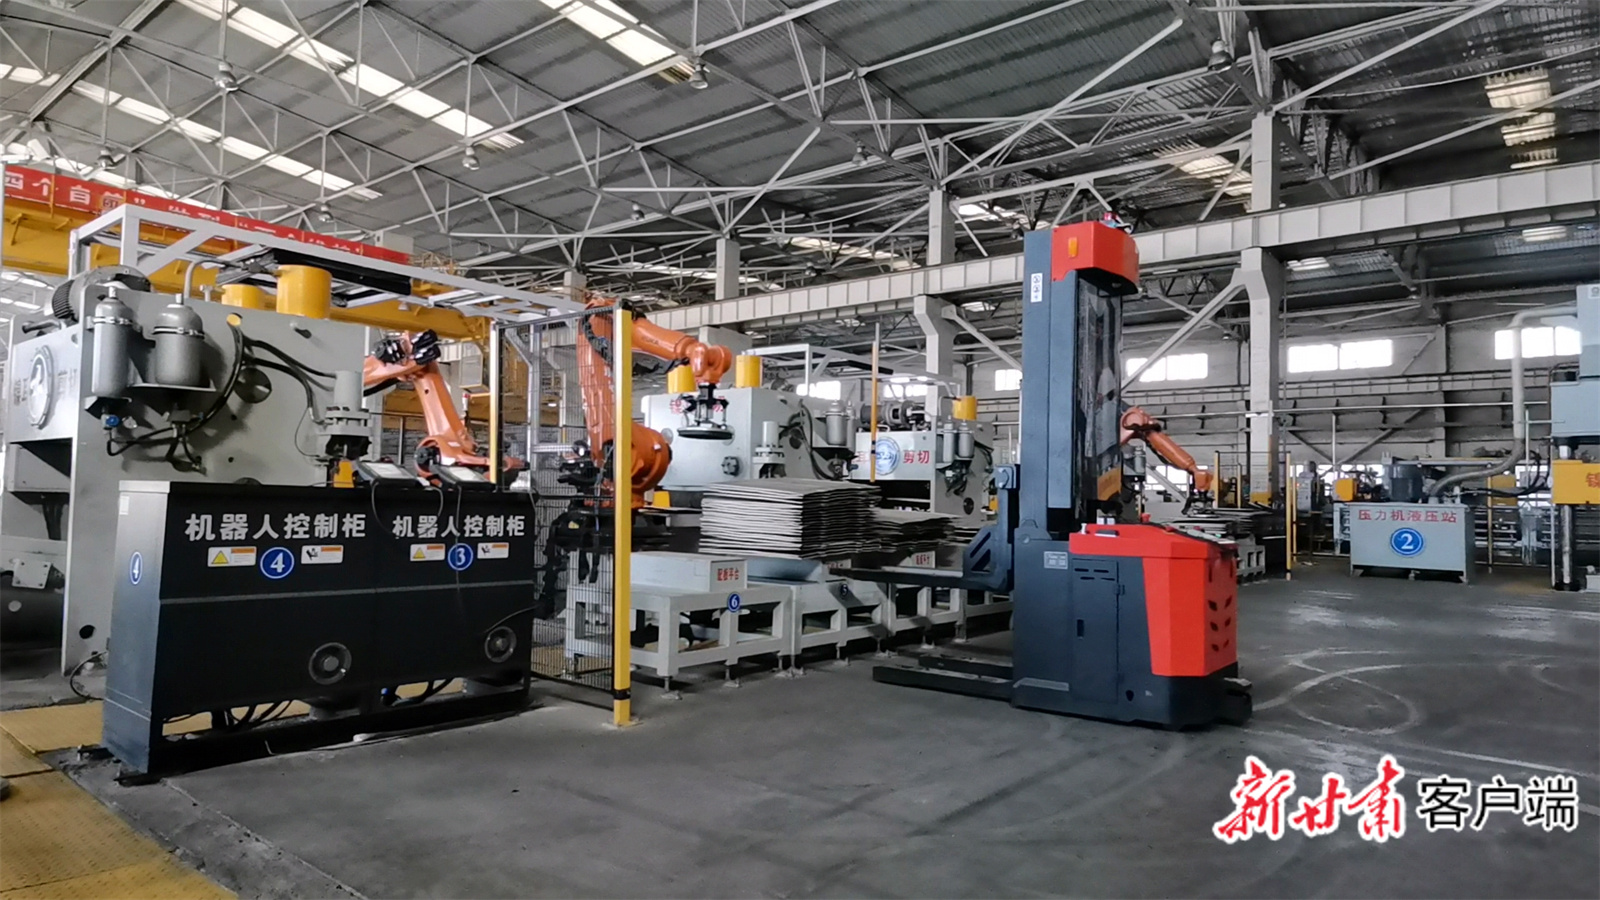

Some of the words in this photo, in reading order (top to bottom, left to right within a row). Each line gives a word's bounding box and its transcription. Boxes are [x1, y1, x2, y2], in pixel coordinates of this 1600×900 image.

[903, 450, 930, 464] 剪切
[1358, 509, 1457, 523] 压力机液压站
[184, 512, 367, 542] 机器人控制柜
[392, 514, 526, 539] 机器人控制柜
[1401, 533, 1414, 550] 2
[270, 552, 285, 573] 4
[455, 547, 465, 566] 3
[131, 558, 140, 579] 4
[731, 595, 738, 608] 6
